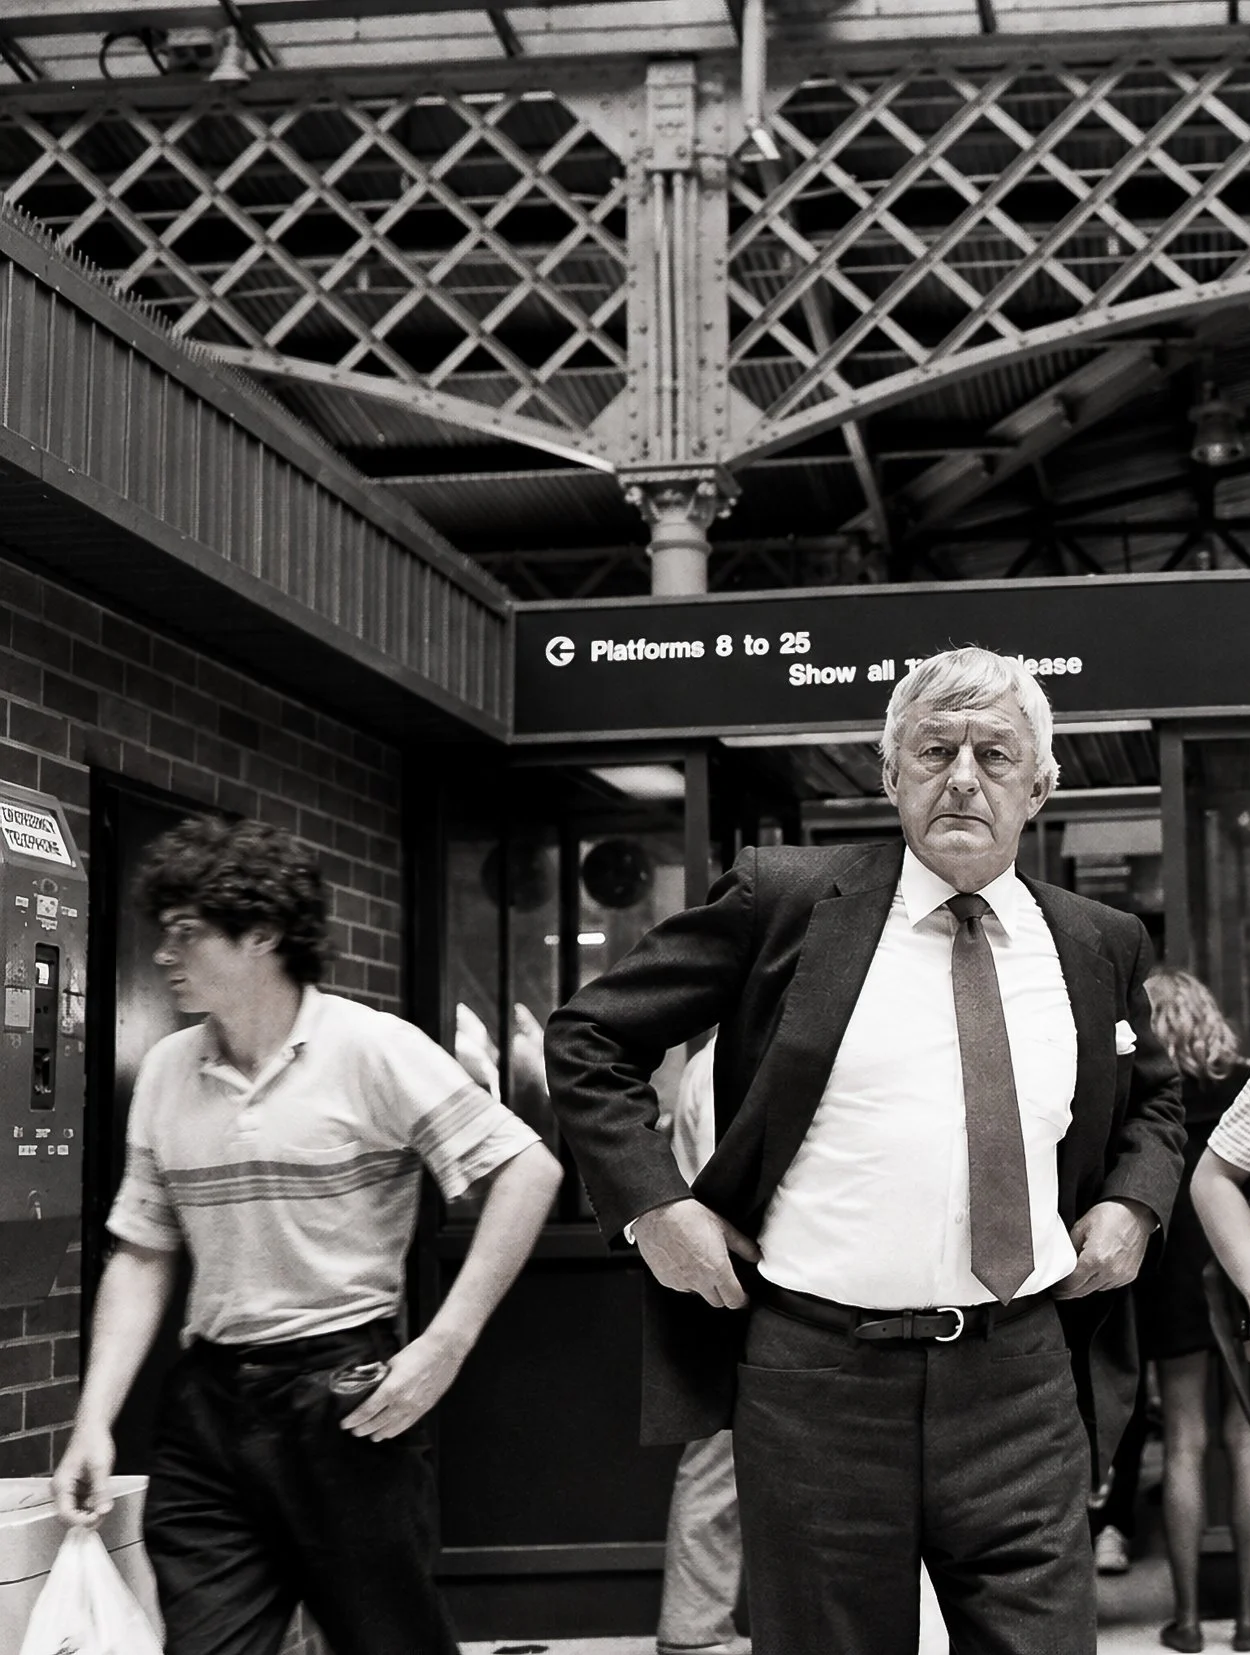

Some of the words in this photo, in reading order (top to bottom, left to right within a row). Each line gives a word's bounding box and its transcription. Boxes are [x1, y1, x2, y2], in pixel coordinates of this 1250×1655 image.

[590, 637, 706, 662] Platforms
[715, 634, 734, 657] 8
[743, 633, 770, 656] to
[779, 631, 811, 655] 25
[788, 663, 857, 687] Show
[866, 658, 896, 683] all
[1004, 653, 1083, 677] lease
